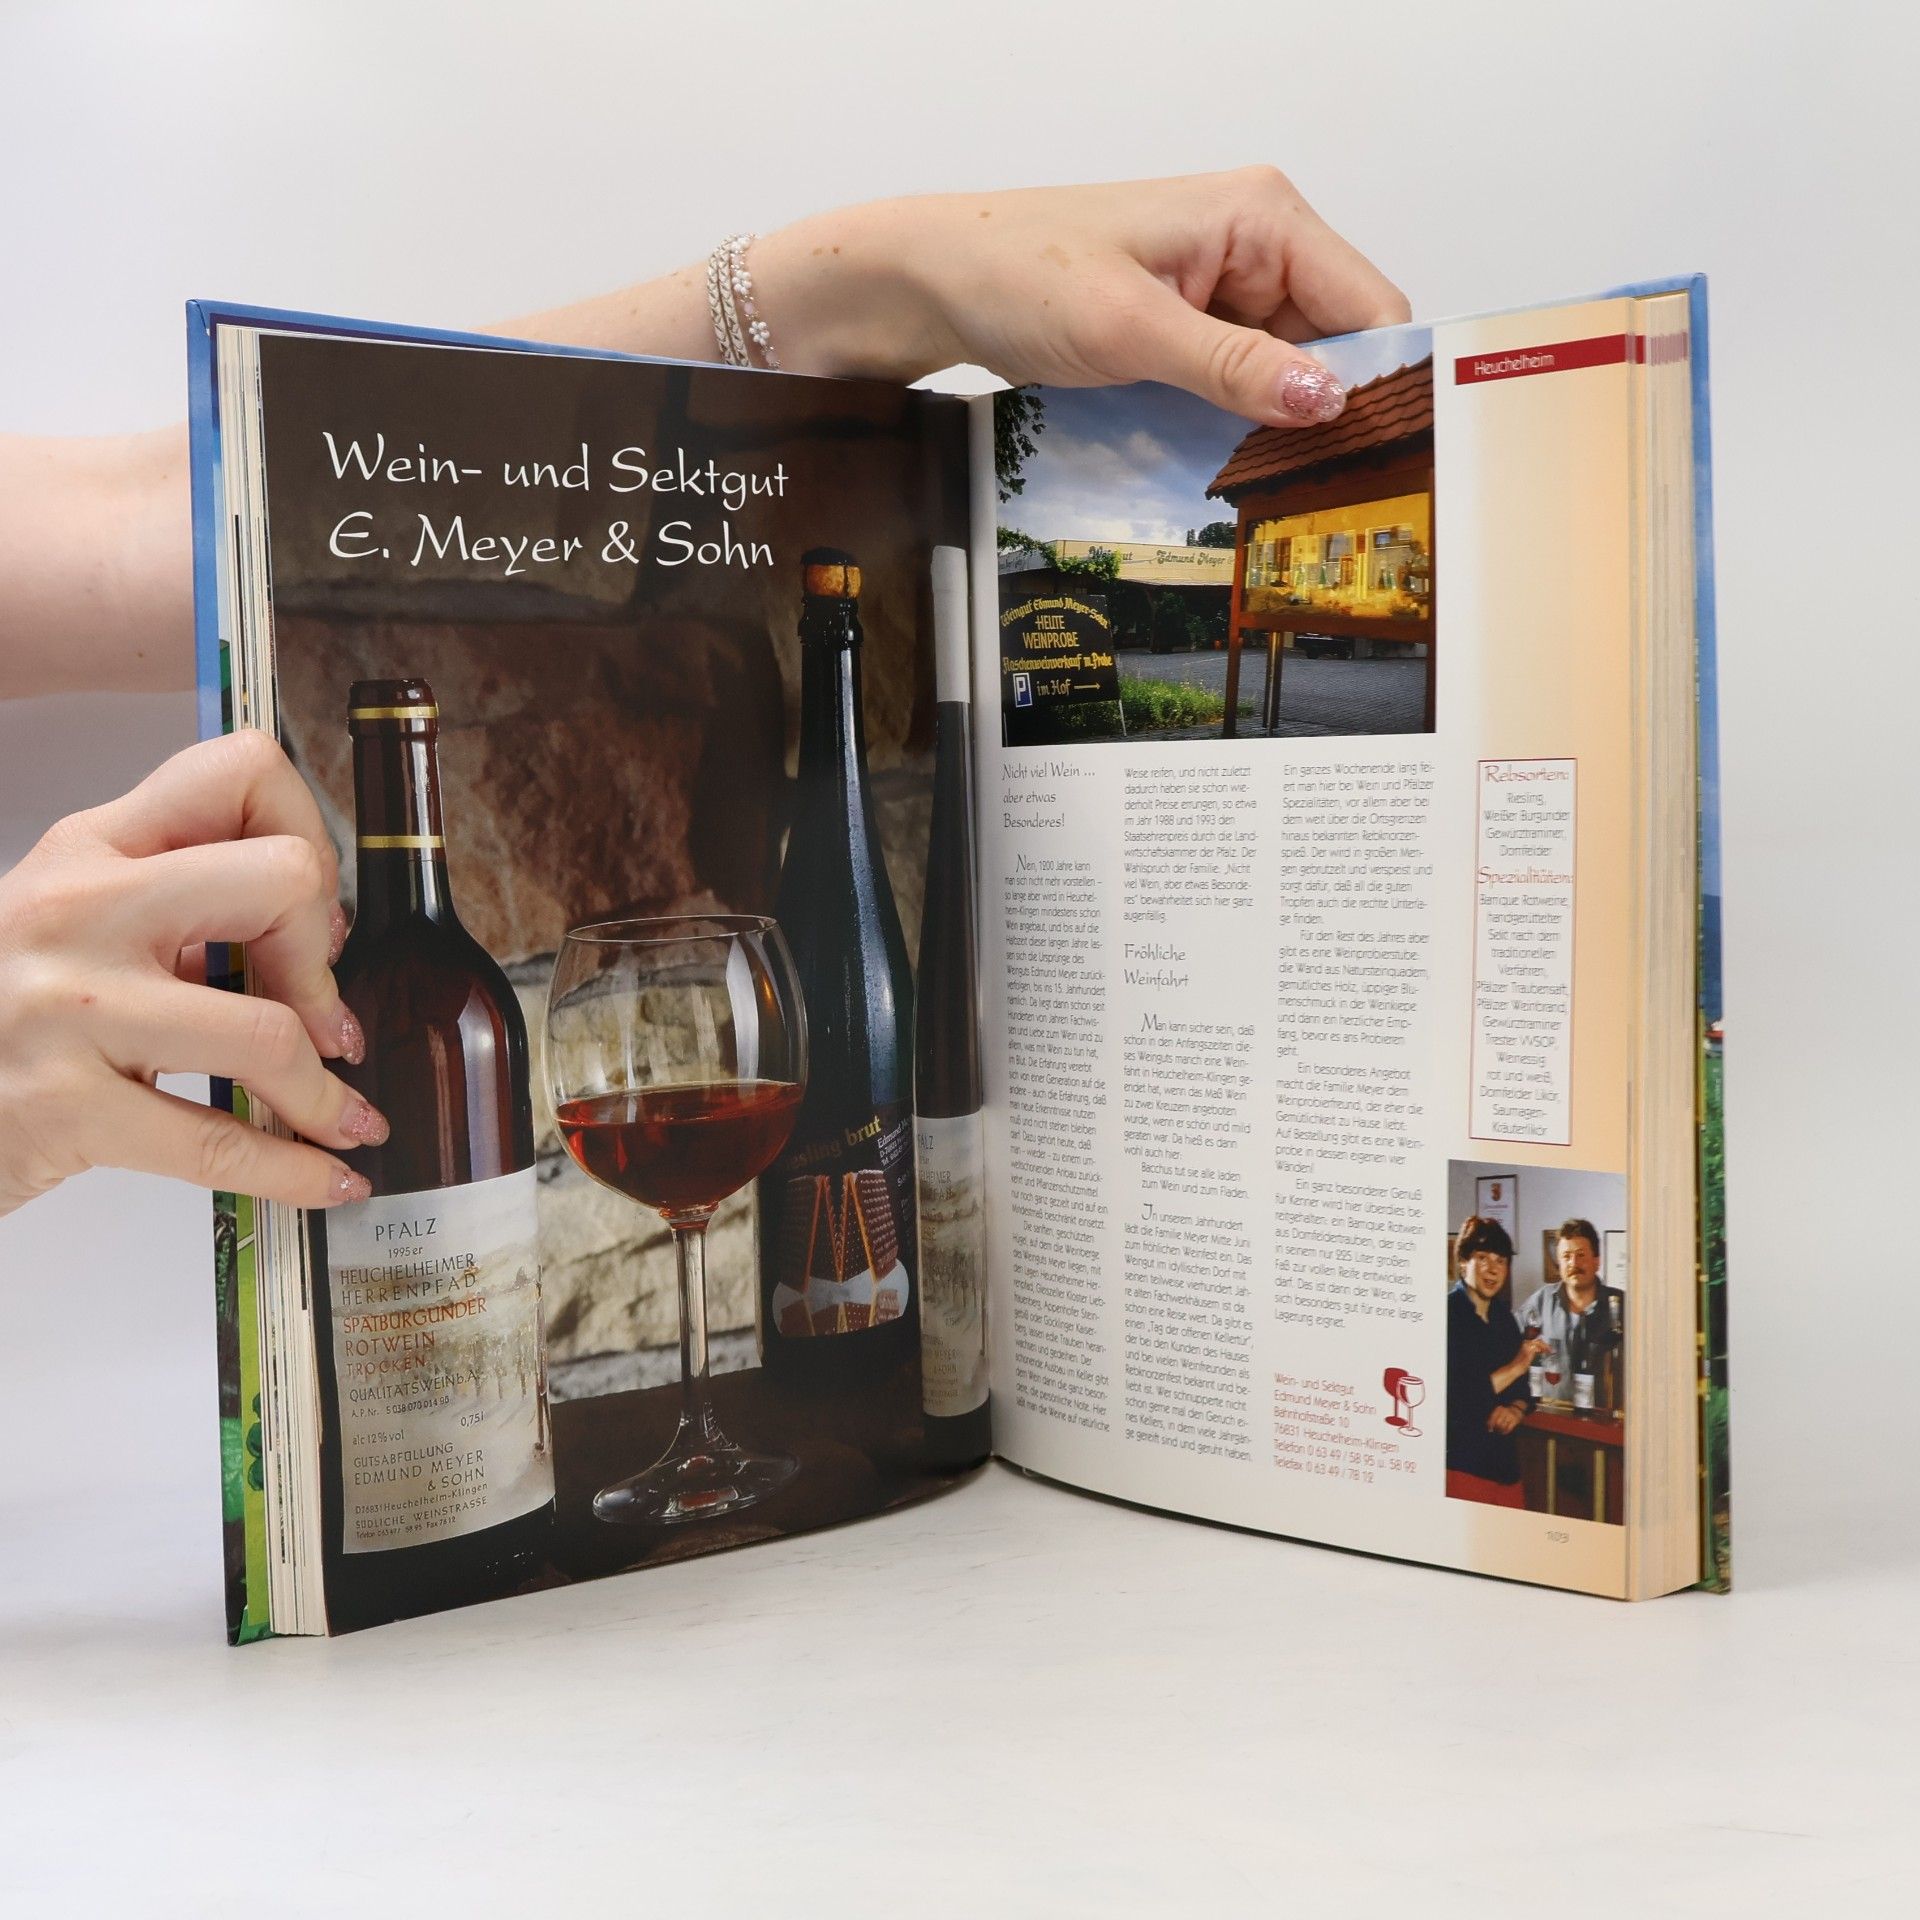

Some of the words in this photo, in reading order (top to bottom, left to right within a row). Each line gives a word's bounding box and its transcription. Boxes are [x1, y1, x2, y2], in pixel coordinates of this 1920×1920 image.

[1474, 353, 1555, 376] Heuchelheim
[322, 431, 482, 484] Wein-
[503, 443, 590, 491] und
[610, 447, 789, 511] Sektgut
[329, 511, 389, 558] E.
[410, 514, 583, 575] Meyer
[602, 521, 639, 564] &
[656, 520, 774, 569] Sohn
[1035, 615, 1065, 629] HEUTE
[1023, 632, 1080, 648] WEINPROBE
[1016, 677, 1026, 701] P
[1002, 762, 1027, 780] Nicht
[1031, 762, 1047, 778] viel
[1050, 762, 1080, 777] Wein
[1179, 768, 1195, 777] und
[1198, 767, 1219, 777] nicht
[1222, 767, 1251, 776] zuletzt
[1284, 765, 1297, 775] Ein
[1485, 765, 1569, 783] Rebsorten:
[1003, 788, 1023, 803] aber
[1026, 791, 1056, 802] etwas
[1003, 812, 1065, 827] Besonderes!
[1137, 816, 1151, 825] Jahr
[1155, 815, 1174, 825] 1988
[1177, 815, 1193, 825] und
[1196, 815, 1216, 825] 1993
[1219, 816, 1235, 825] den
[1124, 943, 1186, 961] Fröhliche
[1124, 968, 1189, 991] Weinfahrt
[1141, 1013, 1167, 1032] Man
[1170, 1021, 1187, 1032] kann
[1189, 1023, 1213, 1033] sicher
[846, 1115, 882, 1147] brut
[376, 1218, 437, 1241] PFALZ
[340, 1253, 475, 1285] HEUCHELHEIMER
[342, 1273, 476, 1305] HERRENPFAD
[346, 1331, 436, 1356] ROTWEIN
[346, 1354, 428, 1377] TROCKEN
[1274, 1372, 1298, 1386] Wein-
[1301, 1379, 1319, 1389] und
[1322, 1380, 1354, 1396] Sektgut
[1274, 1390, 1311, 1406] Edmund
[1313, 1397, 1341, 1410] Meyer
[1353, 1402, 1376, 1415] Sohn
[1274, 1406, 1335, 1425] Bahnhofstraße
[1339, 1416, 1350, 1428] 10
[390, 1429, 404, 1441] vol
[1274, 1439, 1305, 1454] Telefon
[354, 1466, 422, 1485] EDMUND
[432, 1450, 483, 1474] MEYER
[428, 1480, 436, 1491] &
[442, 1466, 484, 1488] SOHN
[414, 1496, 487, 1521] WEINSTRASSE
